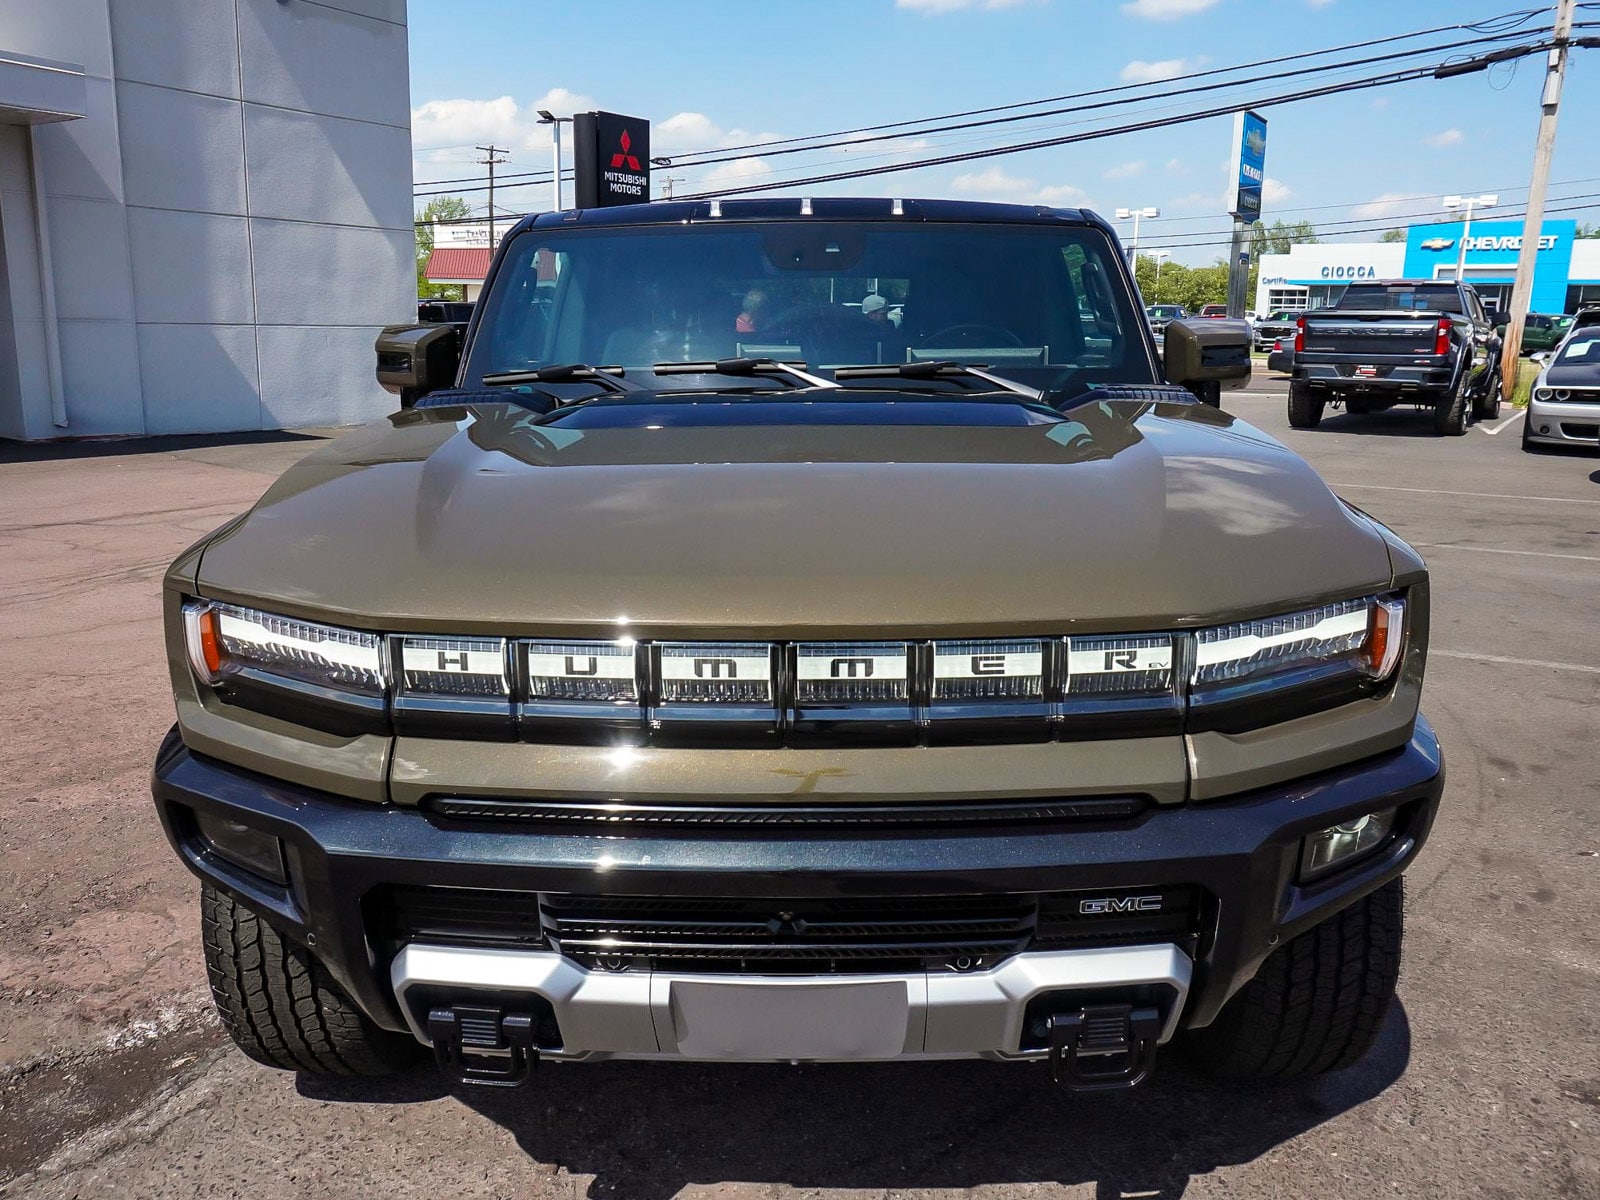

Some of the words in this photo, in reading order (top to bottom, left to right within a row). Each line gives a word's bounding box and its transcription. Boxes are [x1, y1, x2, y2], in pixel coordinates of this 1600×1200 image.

[604, 171, 647, 186] MITSUBISHI
[610, 183, 642, 195] MOTORS
[1459, 235, 1558, 250] CHEVROET
[1321, 266, 1376, 278] CIOCCA
[1262, 277, 1288, 285] Certifie
[1079, 895, 1162, 914] GMC
